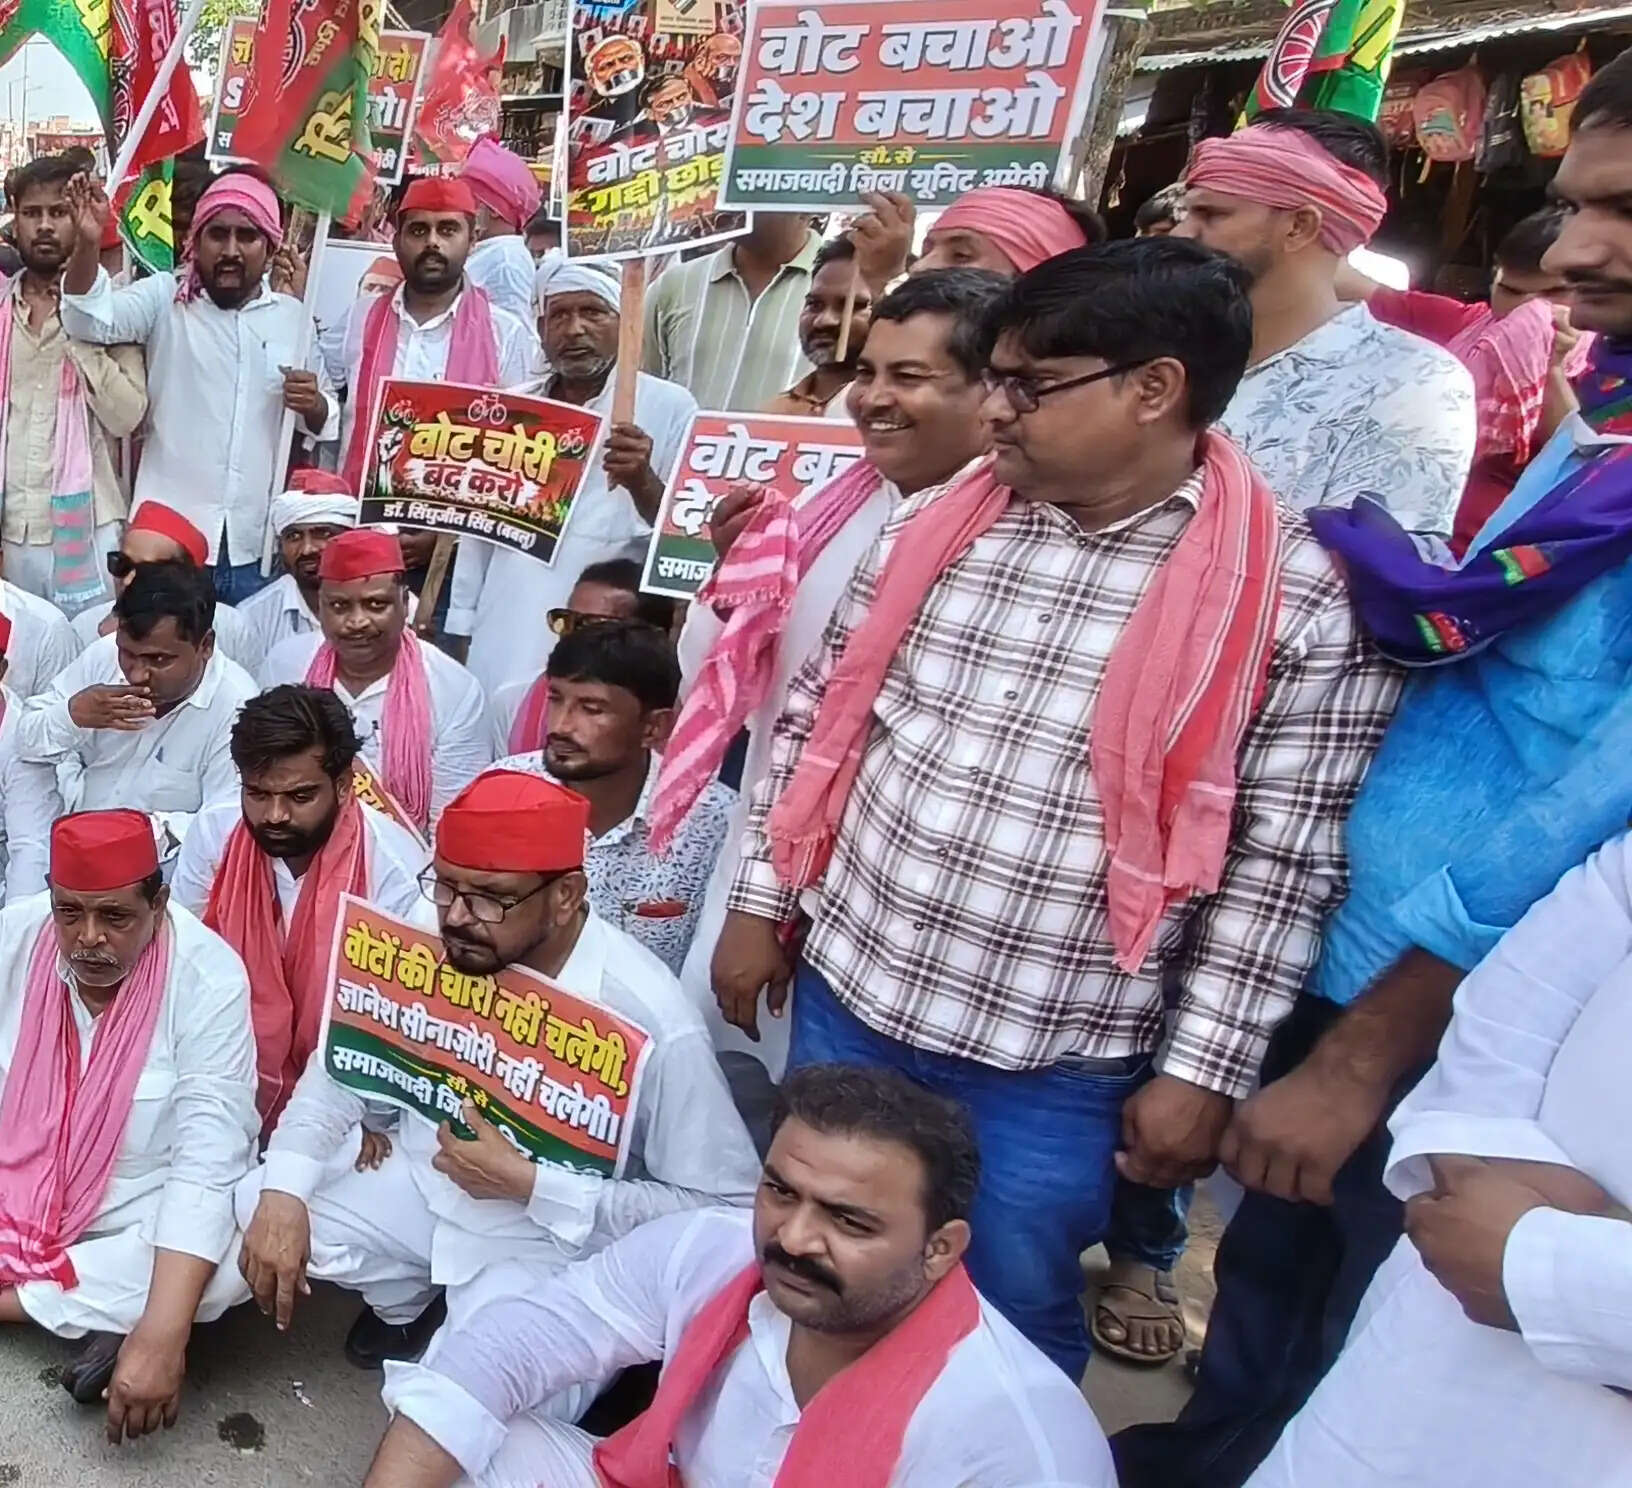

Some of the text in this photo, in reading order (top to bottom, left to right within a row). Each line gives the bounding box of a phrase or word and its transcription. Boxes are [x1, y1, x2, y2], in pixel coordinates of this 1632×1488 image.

[757, 0, 1082, 76] वोट बचाओ
[744, 70, 1065, 144] देश बचाओ
[587, 141, 660, 184] वोट
[588, 168, 661, 214] गद्दी
[735, 163, 846, 194] समाजवादी
[849, 165, 906, 194] जिला
[909, 166, 977, 200] यूनिट
[410, 411, 560, 484] वोट चोरी
[689, 423, 788, 483] वोट
[423, 457, 524, 506] बंद करो
[343, 920, 401, 982] वोटों
[396, 944, 439, 996] की
[495, 986, 551, 1047] नहीं
[545, 1013, 629, 1096] चलेगी,
[337, 978, 400, 1030] ज्ञानेश
[496, 1050, 544, 1104] नहीं
[333, 1045, 435, 1105] समाजवादी
